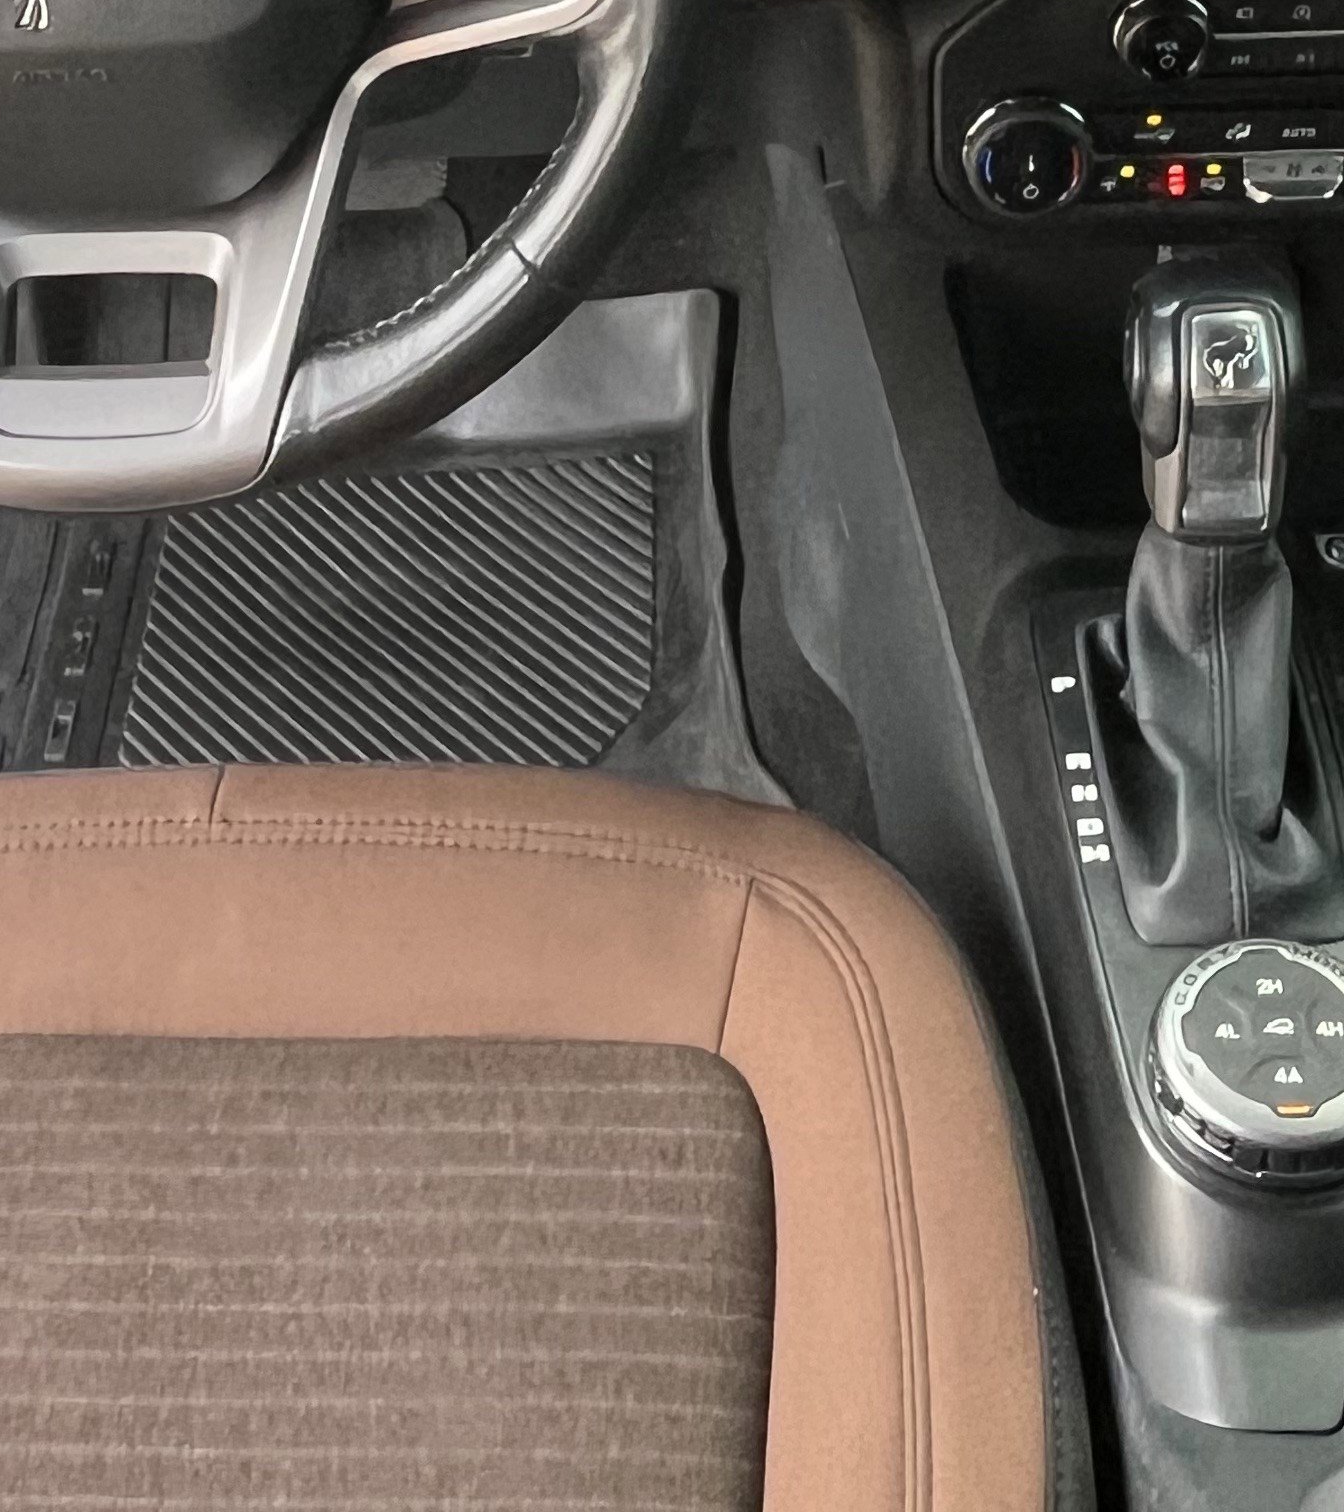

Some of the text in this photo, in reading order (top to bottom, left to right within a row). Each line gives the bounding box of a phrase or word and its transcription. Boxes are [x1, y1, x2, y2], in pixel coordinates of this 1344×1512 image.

[1255, 978, 1285, 996] 2H
[1214, 1023, 1241, 1039] 4L
[1315, 1021, 1344, 1037] 4H
[1274, 1066, 1304, 1084] 4A
